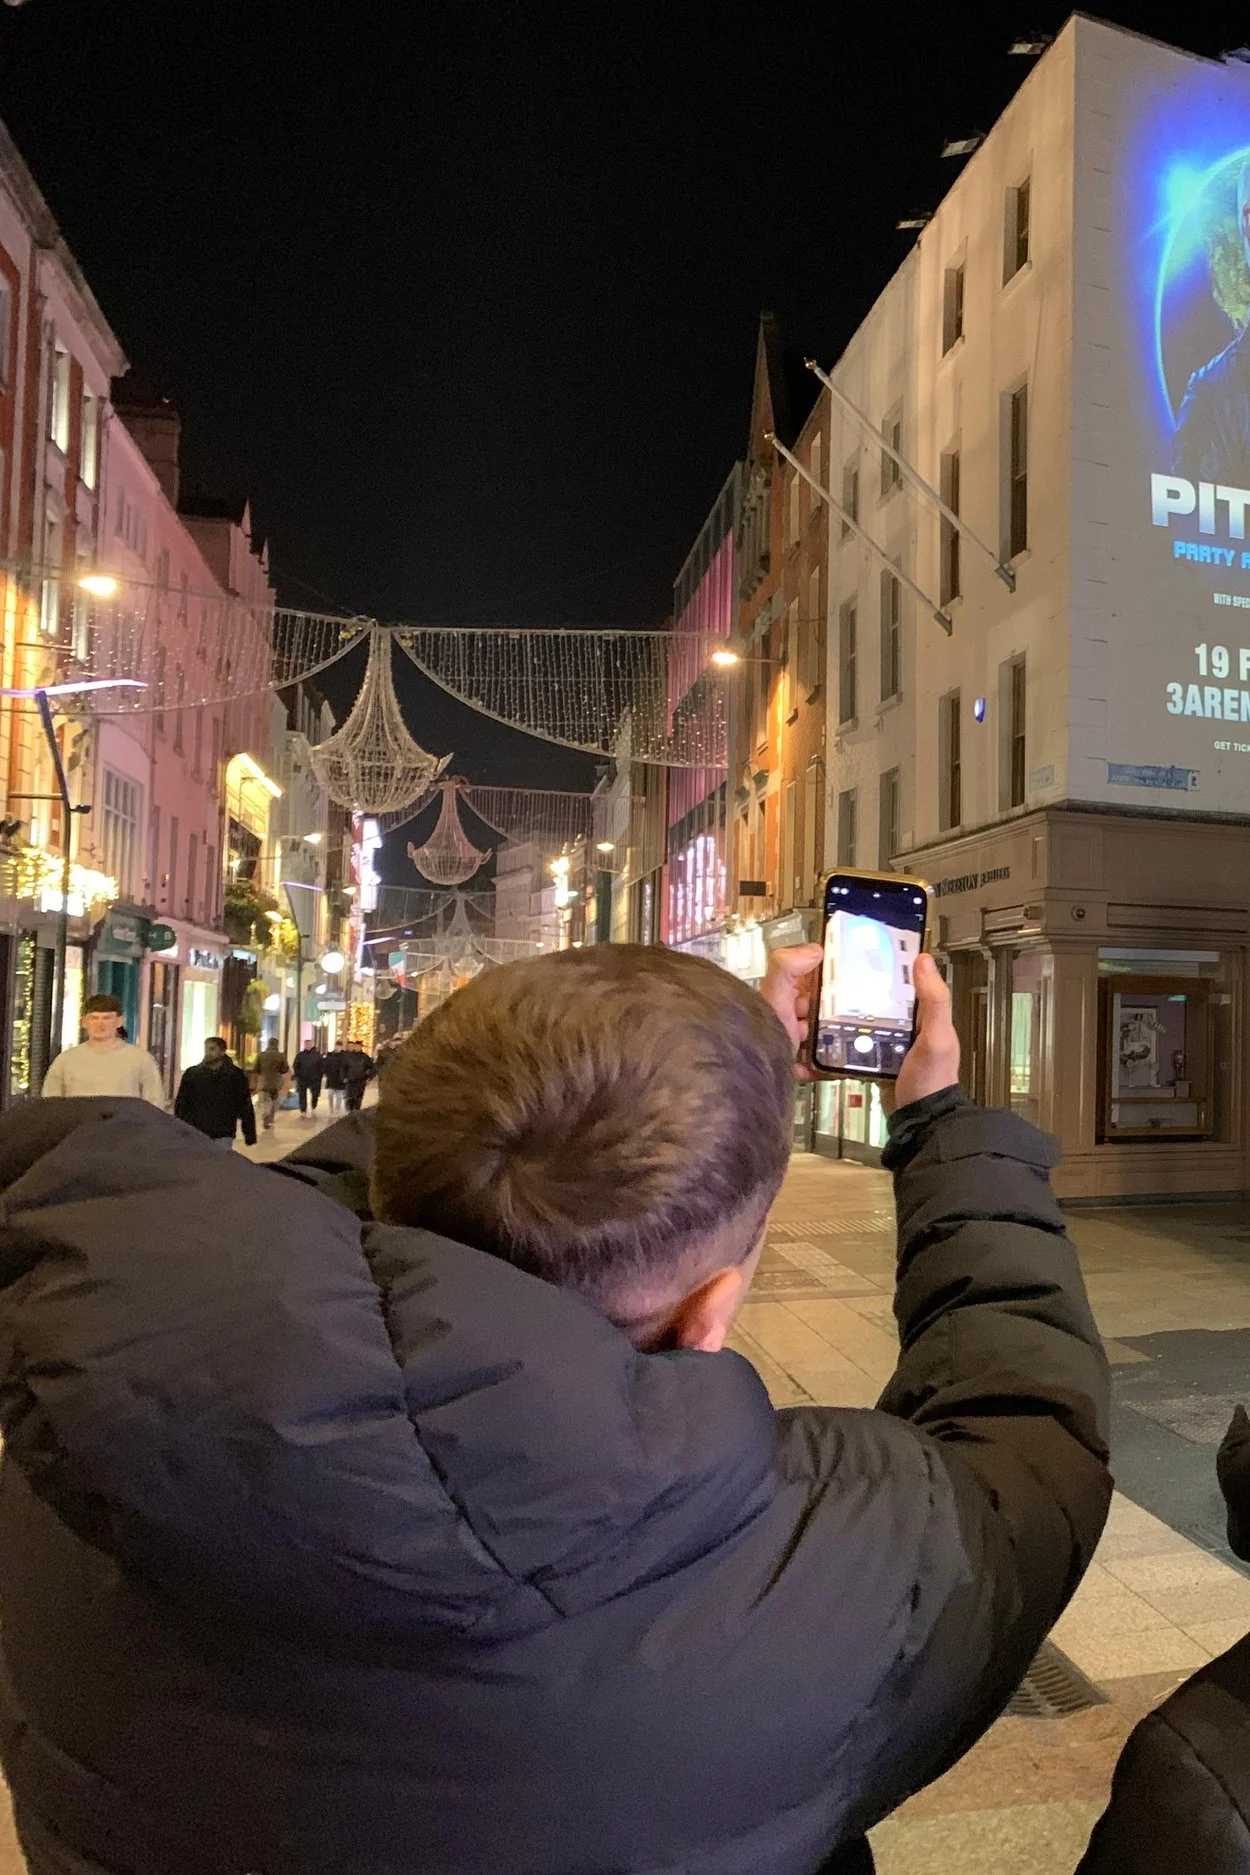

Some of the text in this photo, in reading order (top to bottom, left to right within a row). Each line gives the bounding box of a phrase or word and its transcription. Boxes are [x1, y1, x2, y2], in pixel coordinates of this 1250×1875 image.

[1174, 540, 1235, 567] PARTY
[1213, 592, 1231, 606] WITH
[1195, 643, 1230, 679] 19
[1214, 740, 1231, 750] GET
